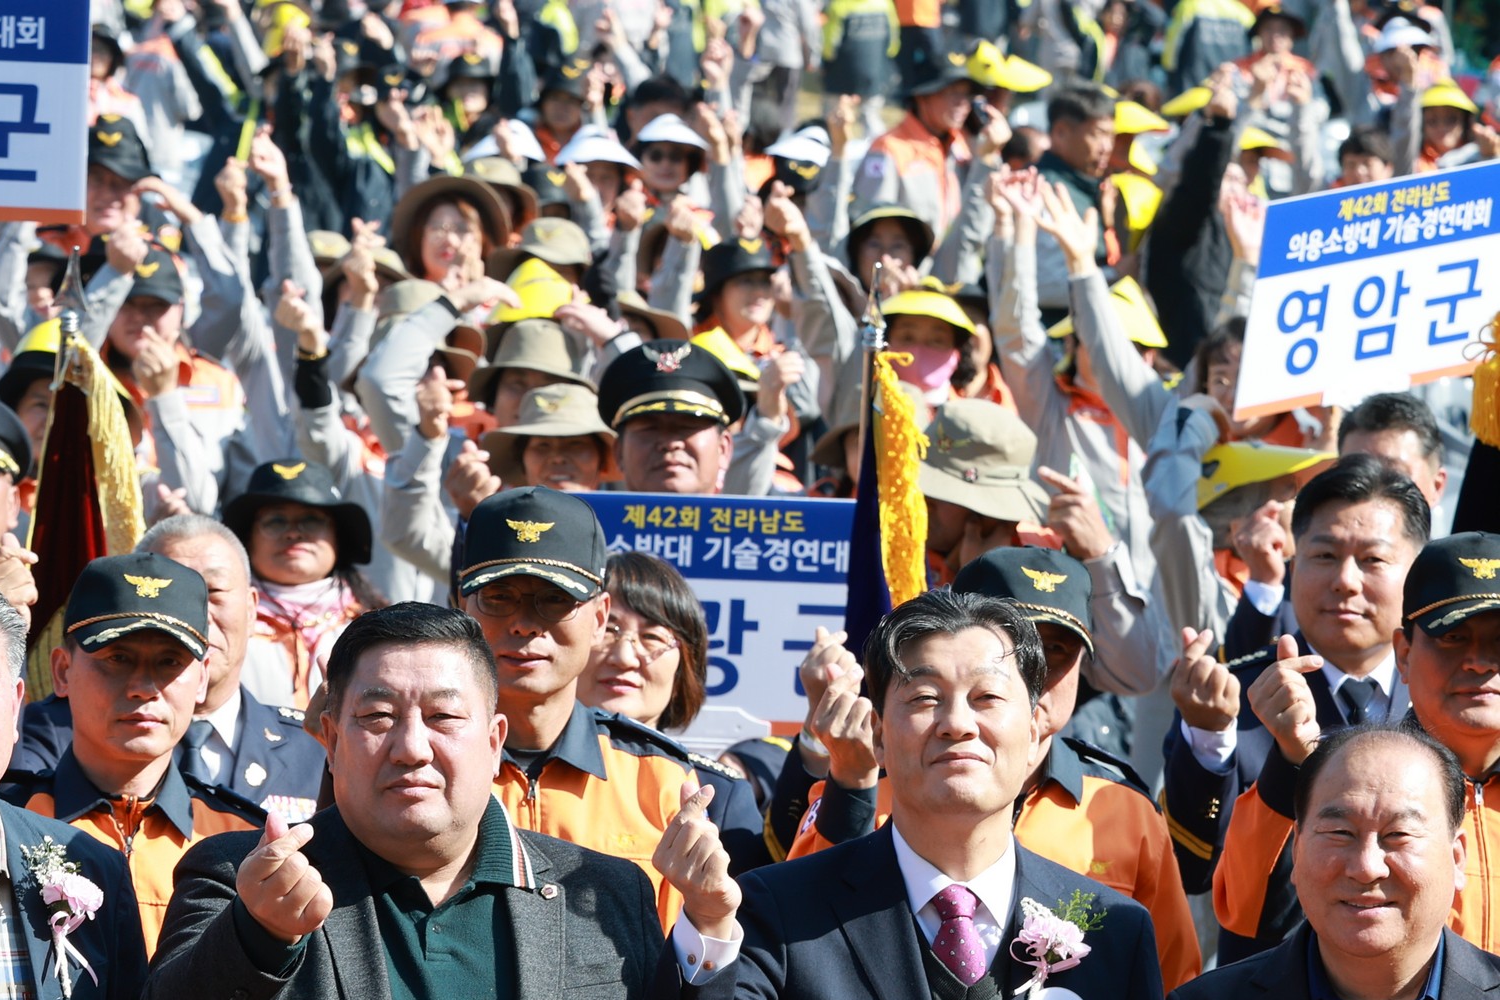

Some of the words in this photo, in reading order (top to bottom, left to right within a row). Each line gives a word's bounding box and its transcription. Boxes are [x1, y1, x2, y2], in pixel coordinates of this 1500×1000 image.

[1337, 192, 1388, 220] 제42회
[1390, 181, 1451, 212] 전라남도
[1286, 218, 1379, 262] 의용소방대
[1383, 198, 1493, 244] 기술경연대회
[1277, 258, 1482, 376] 영암군
[622, 504, 701, 531] 제42회
[708, 506, 806, 534] 전라남도
